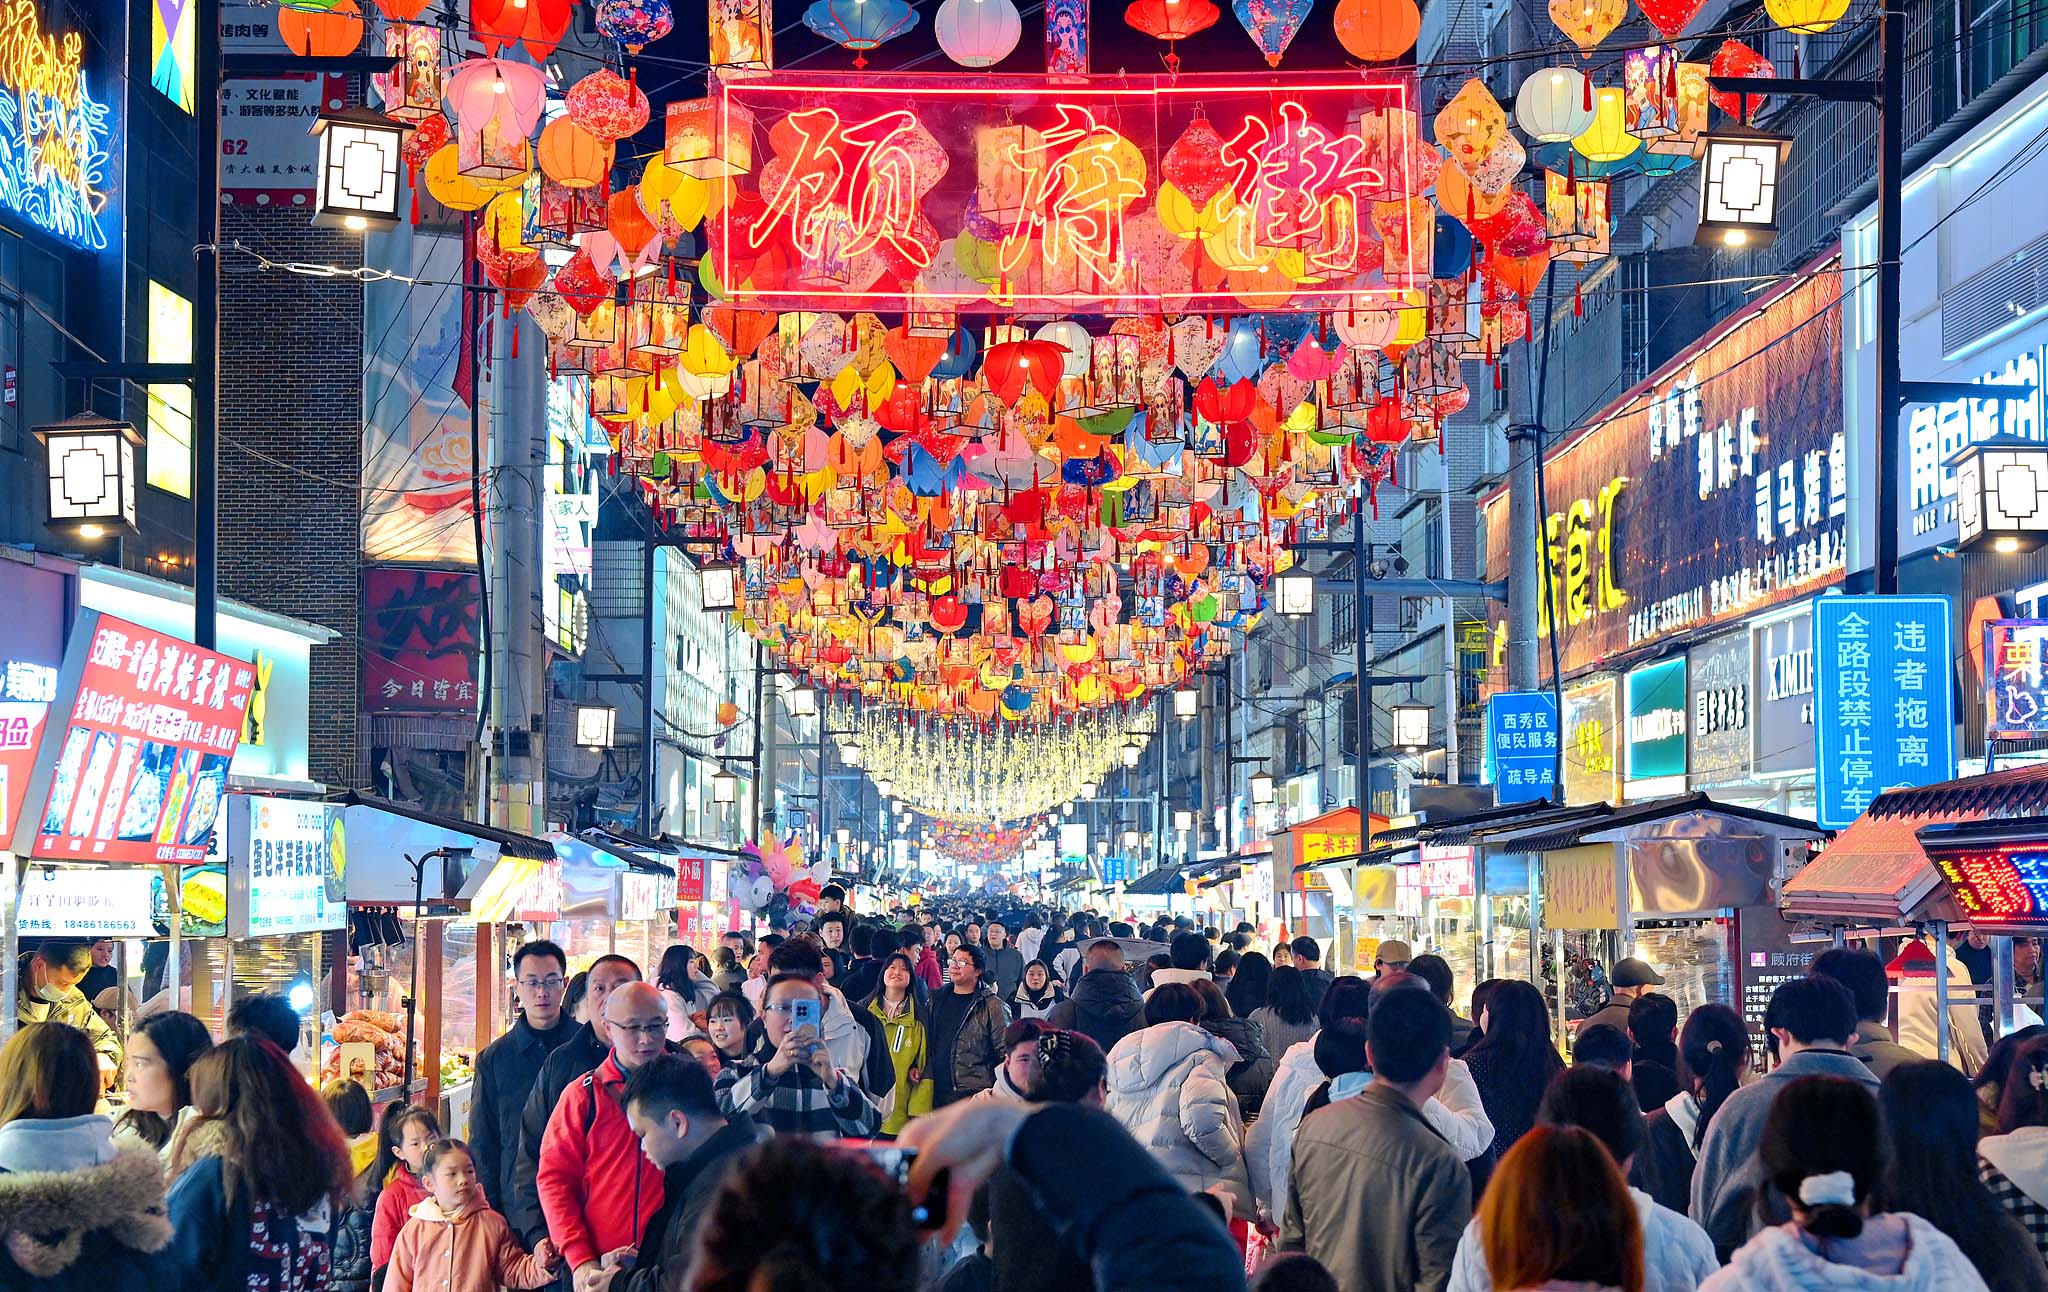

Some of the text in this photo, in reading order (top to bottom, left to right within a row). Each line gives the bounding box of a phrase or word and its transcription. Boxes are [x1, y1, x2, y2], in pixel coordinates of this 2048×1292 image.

[749, 101, 1386, 284] 顾府街
[1755, 432, 1846, 546] 司马烤鱼
[382, 677, 474, 701] 今日皆宜
[1893, 620, 1929, 768] 违者拖离
[1502, 712, 1549, 729] 西秀区
[1836, 610, 1873, 815] 全路段禁止停车
[1497, 731, 1558, 750] 便民服务
[1507, 767, 1554, 786] 疏导点
[1771, 952, 1814, 967] 顾府街
